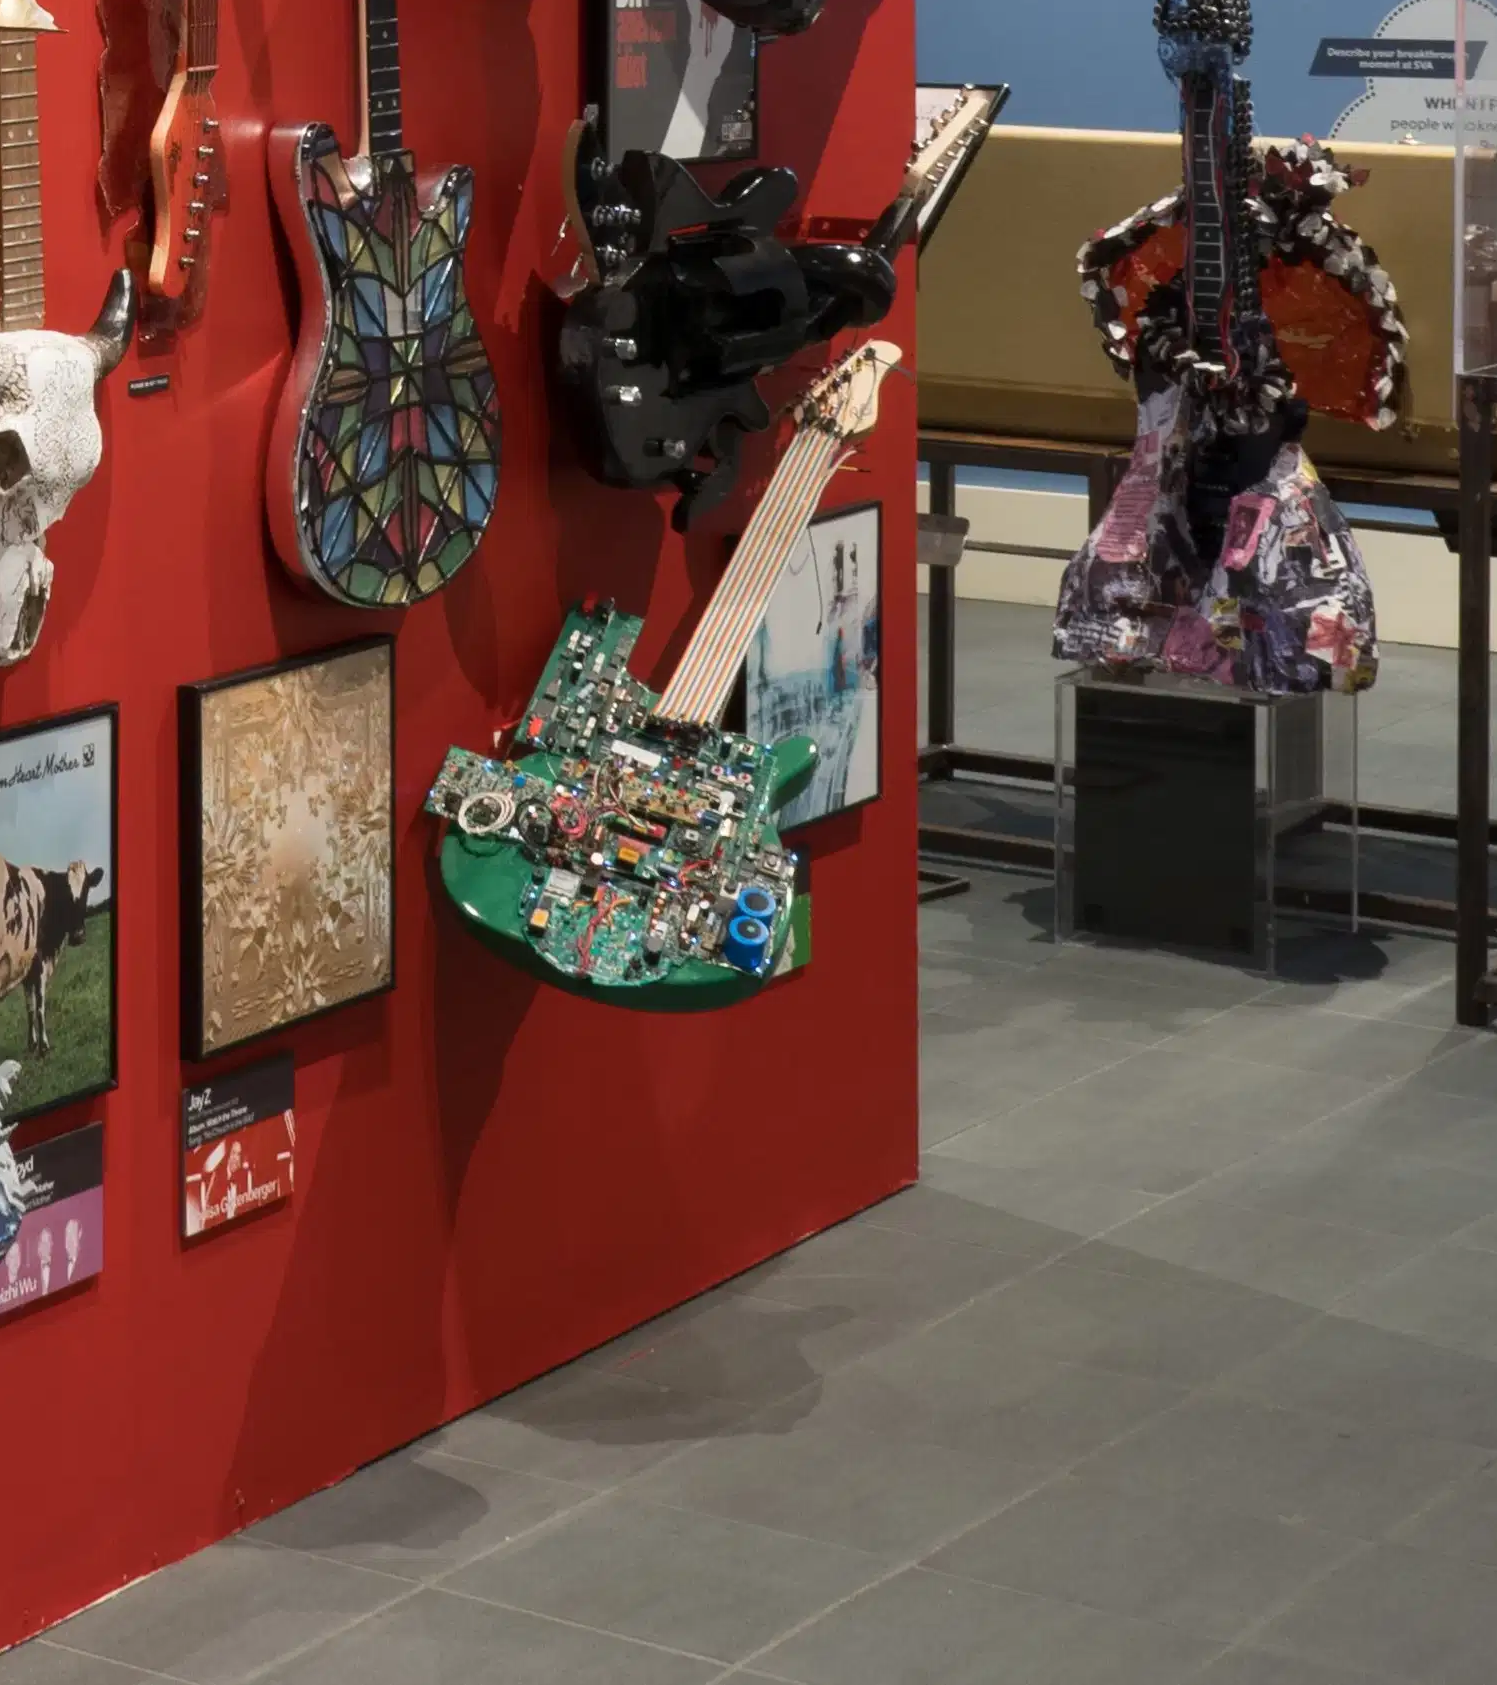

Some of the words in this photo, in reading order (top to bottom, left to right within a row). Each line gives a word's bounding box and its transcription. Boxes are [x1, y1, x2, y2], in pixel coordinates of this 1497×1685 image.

[1390, 118, 1440, 134] people
[42, 752, 80, 779] Mother
[18, 1275, 38, 1297] Wu
